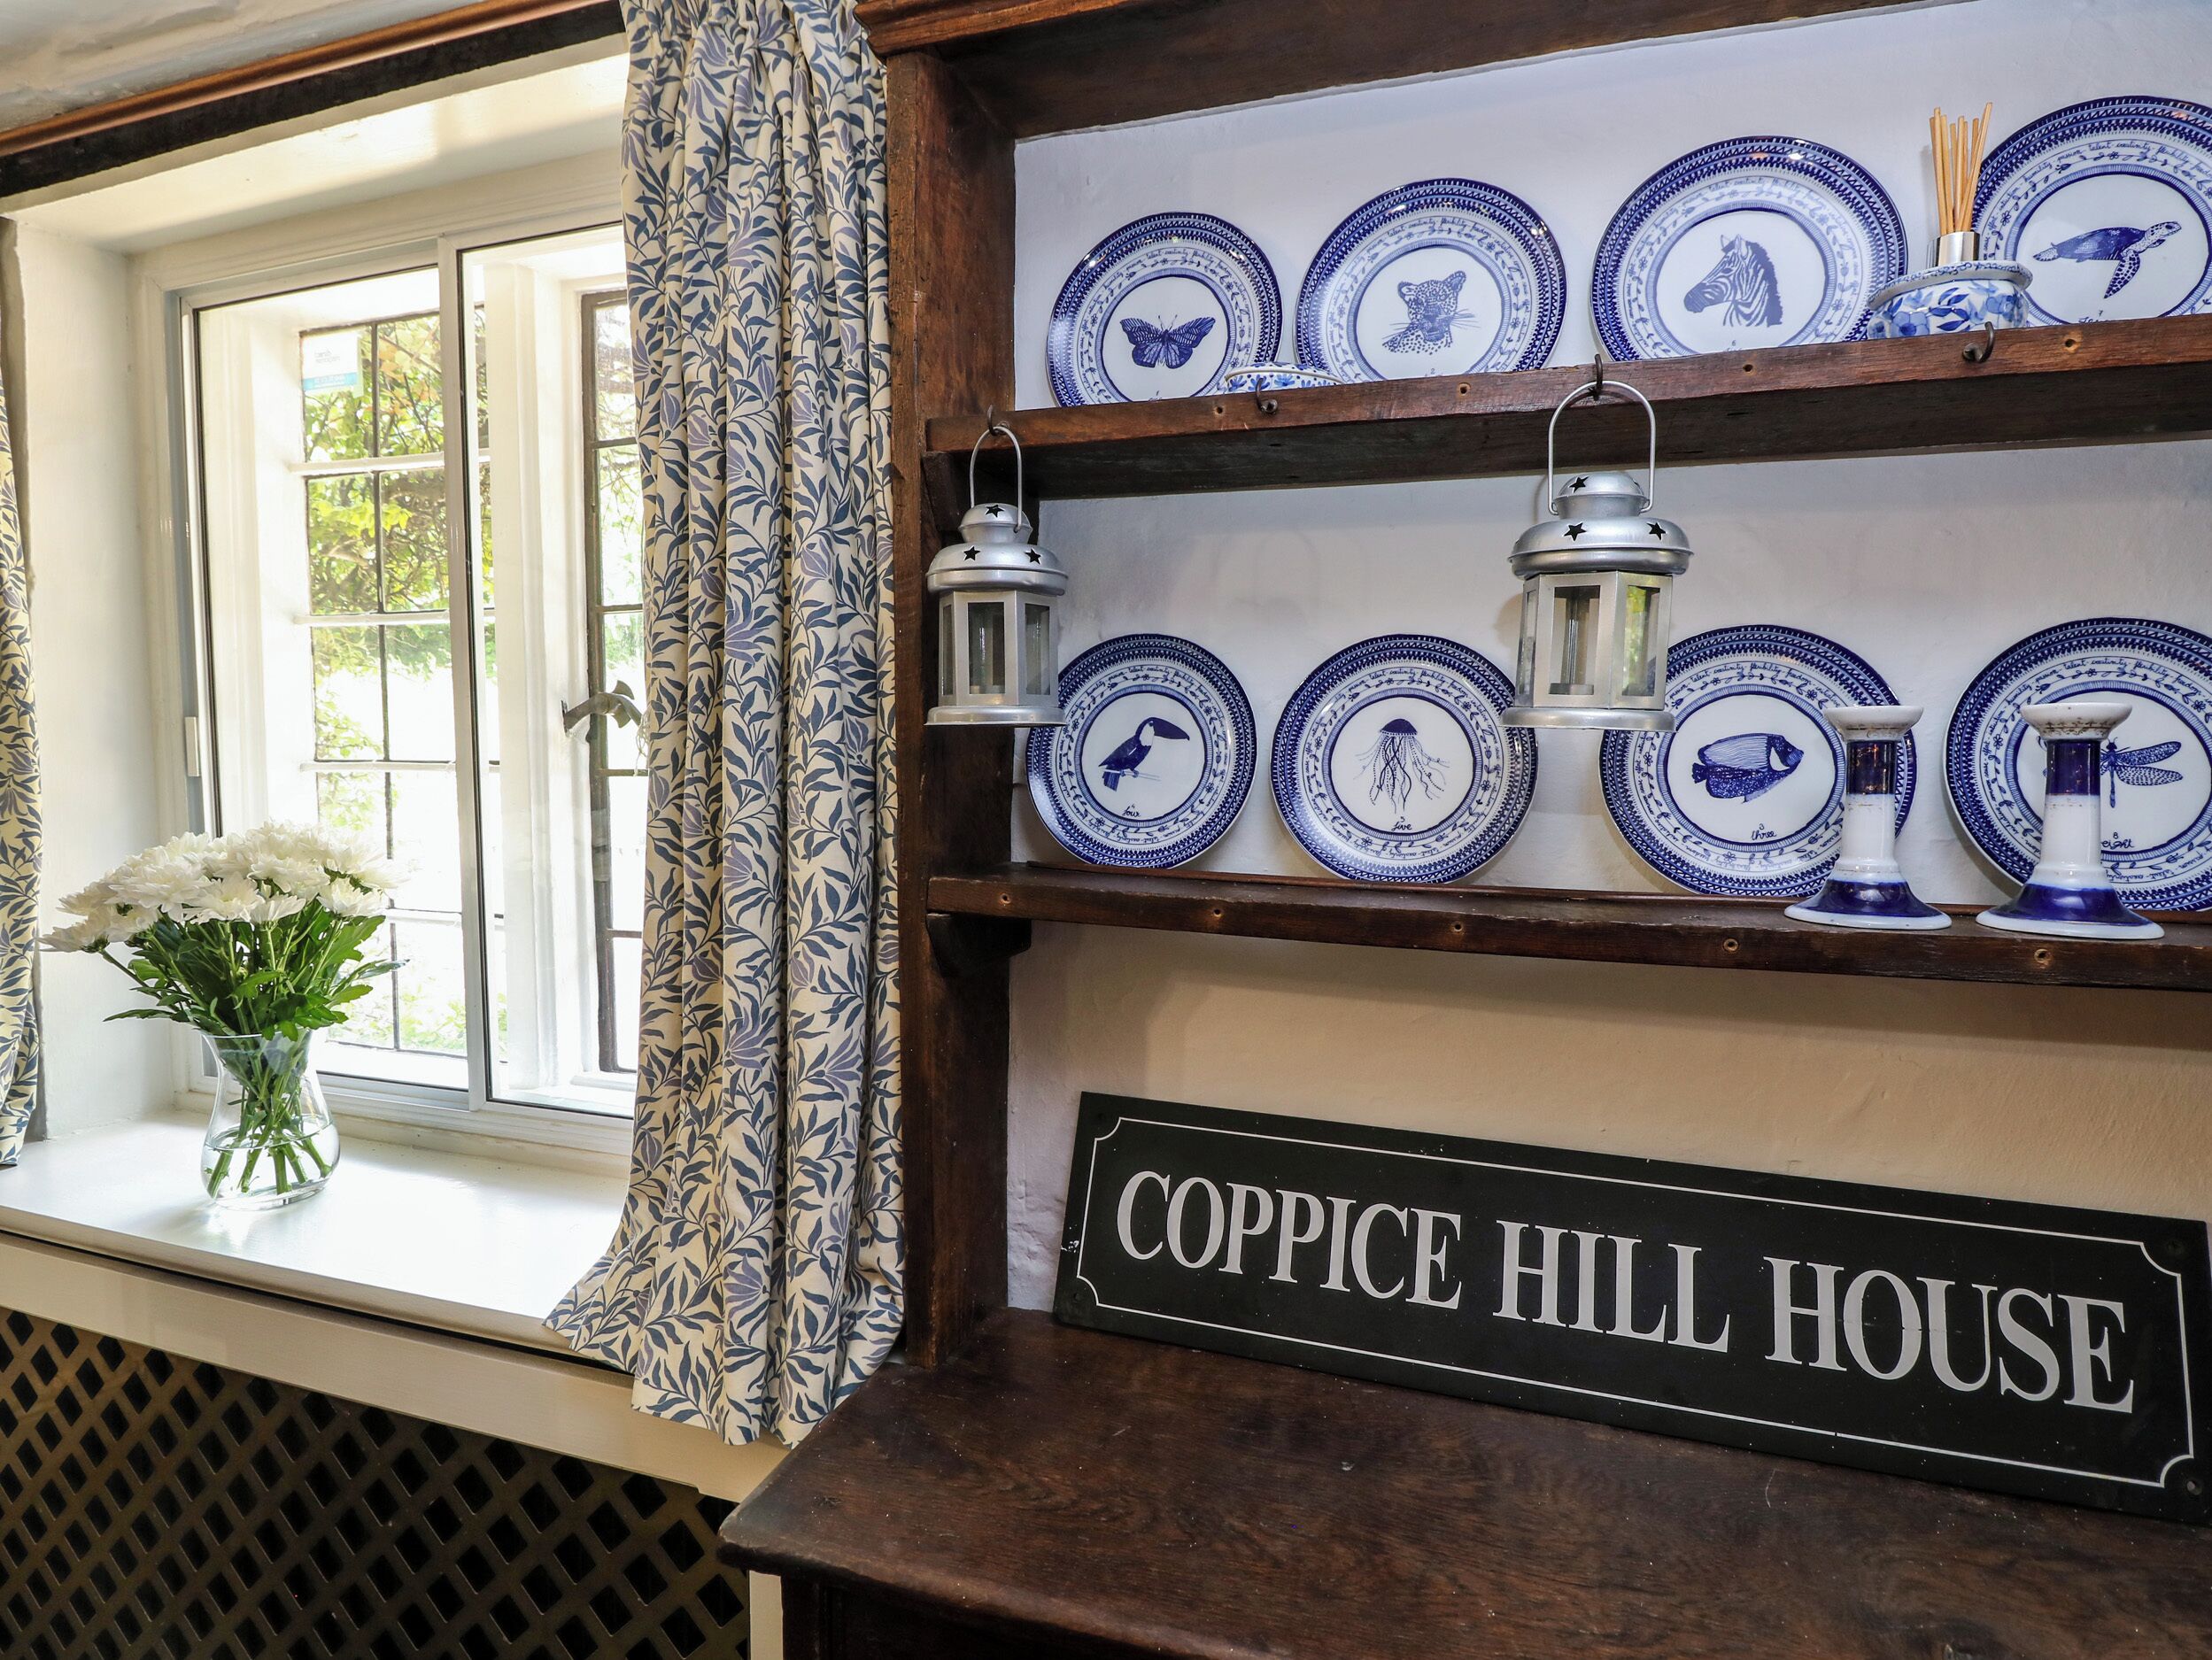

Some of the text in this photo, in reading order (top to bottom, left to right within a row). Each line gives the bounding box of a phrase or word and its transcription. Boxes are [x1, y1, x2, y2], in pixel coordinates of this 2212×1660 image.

[2023, 162, 2053, 182] humility
[2088, 142, 2110, 151] talent
[1368, 670, 1386, 680] talent
[1669, 684, 1688, 700] passion
[1690, 669, 1710, 683] talent
[1713, 664, 1744, 674] creativity
[1750, 662, 1782, 674] flexibility
[1785, 669, 1811, 684] freedom
[1815, 686, 1840, 707] initiative
[2007, 684, 2032, 705] humility
[2063, 660, 2085, 669] talent
[2173, 675, 2201, 695] freedom
[1121, 807, 1141, 818] four
[1391, 822, 1413, 831] five
[1750, 830, 1777, 841] three
[2101, 838, 2134, 850] eight
[1116, 1170, 2135, 1414] COPPICE HILL HOUSE
